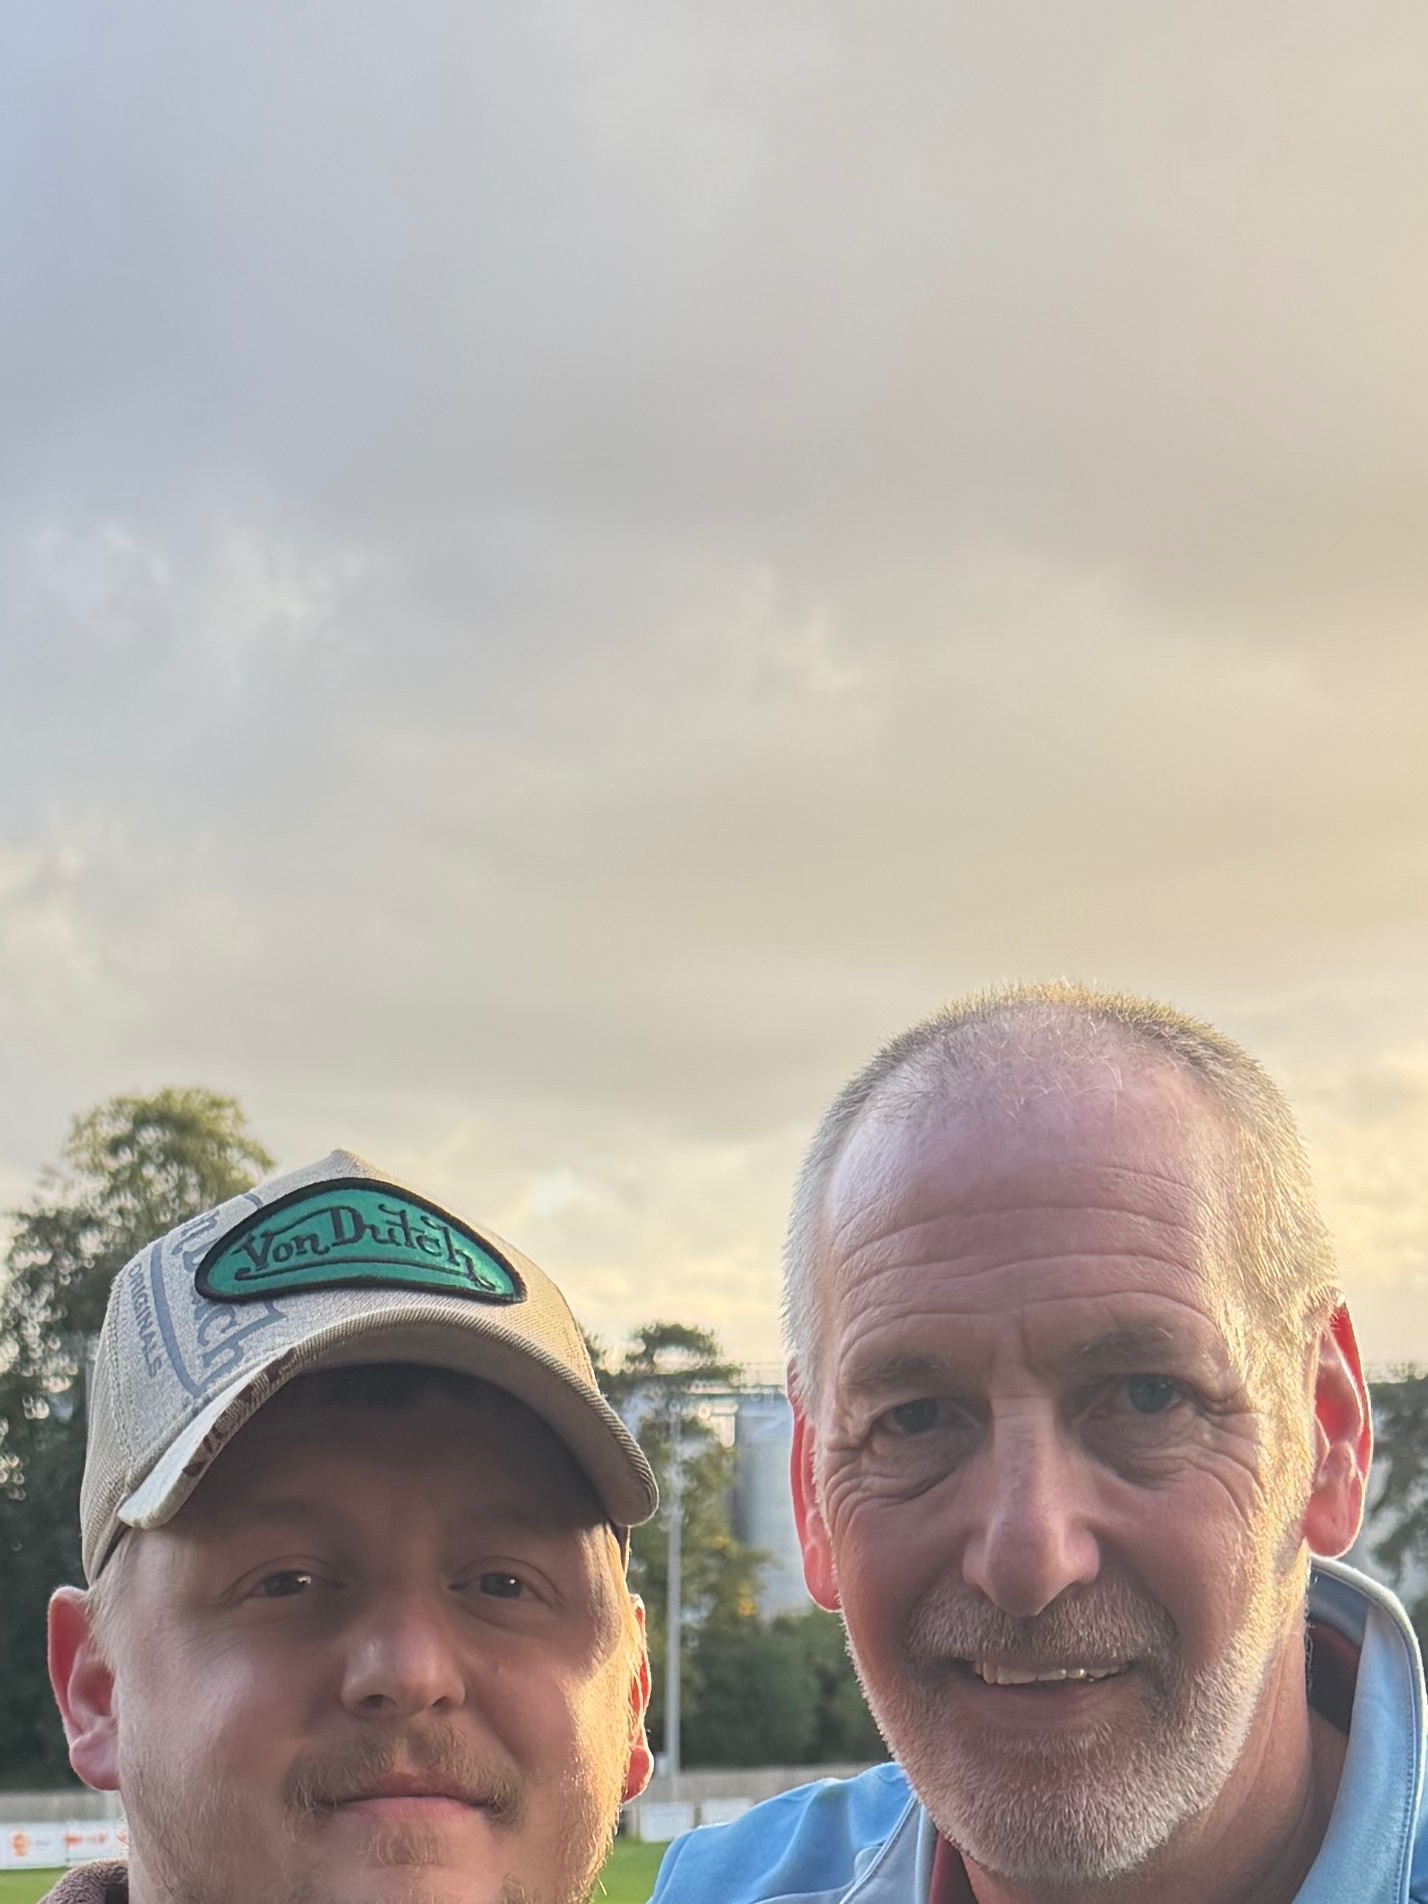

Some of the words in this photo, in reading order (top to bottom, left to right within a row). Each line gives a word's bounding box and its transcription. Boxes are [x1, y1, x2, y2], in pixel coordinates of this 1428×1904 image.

[233, 1224, 330, 1271] Von
[327, 1203, 496, 1291] Dutch
[127, 1262, 164, 1378] ORIGINALS
